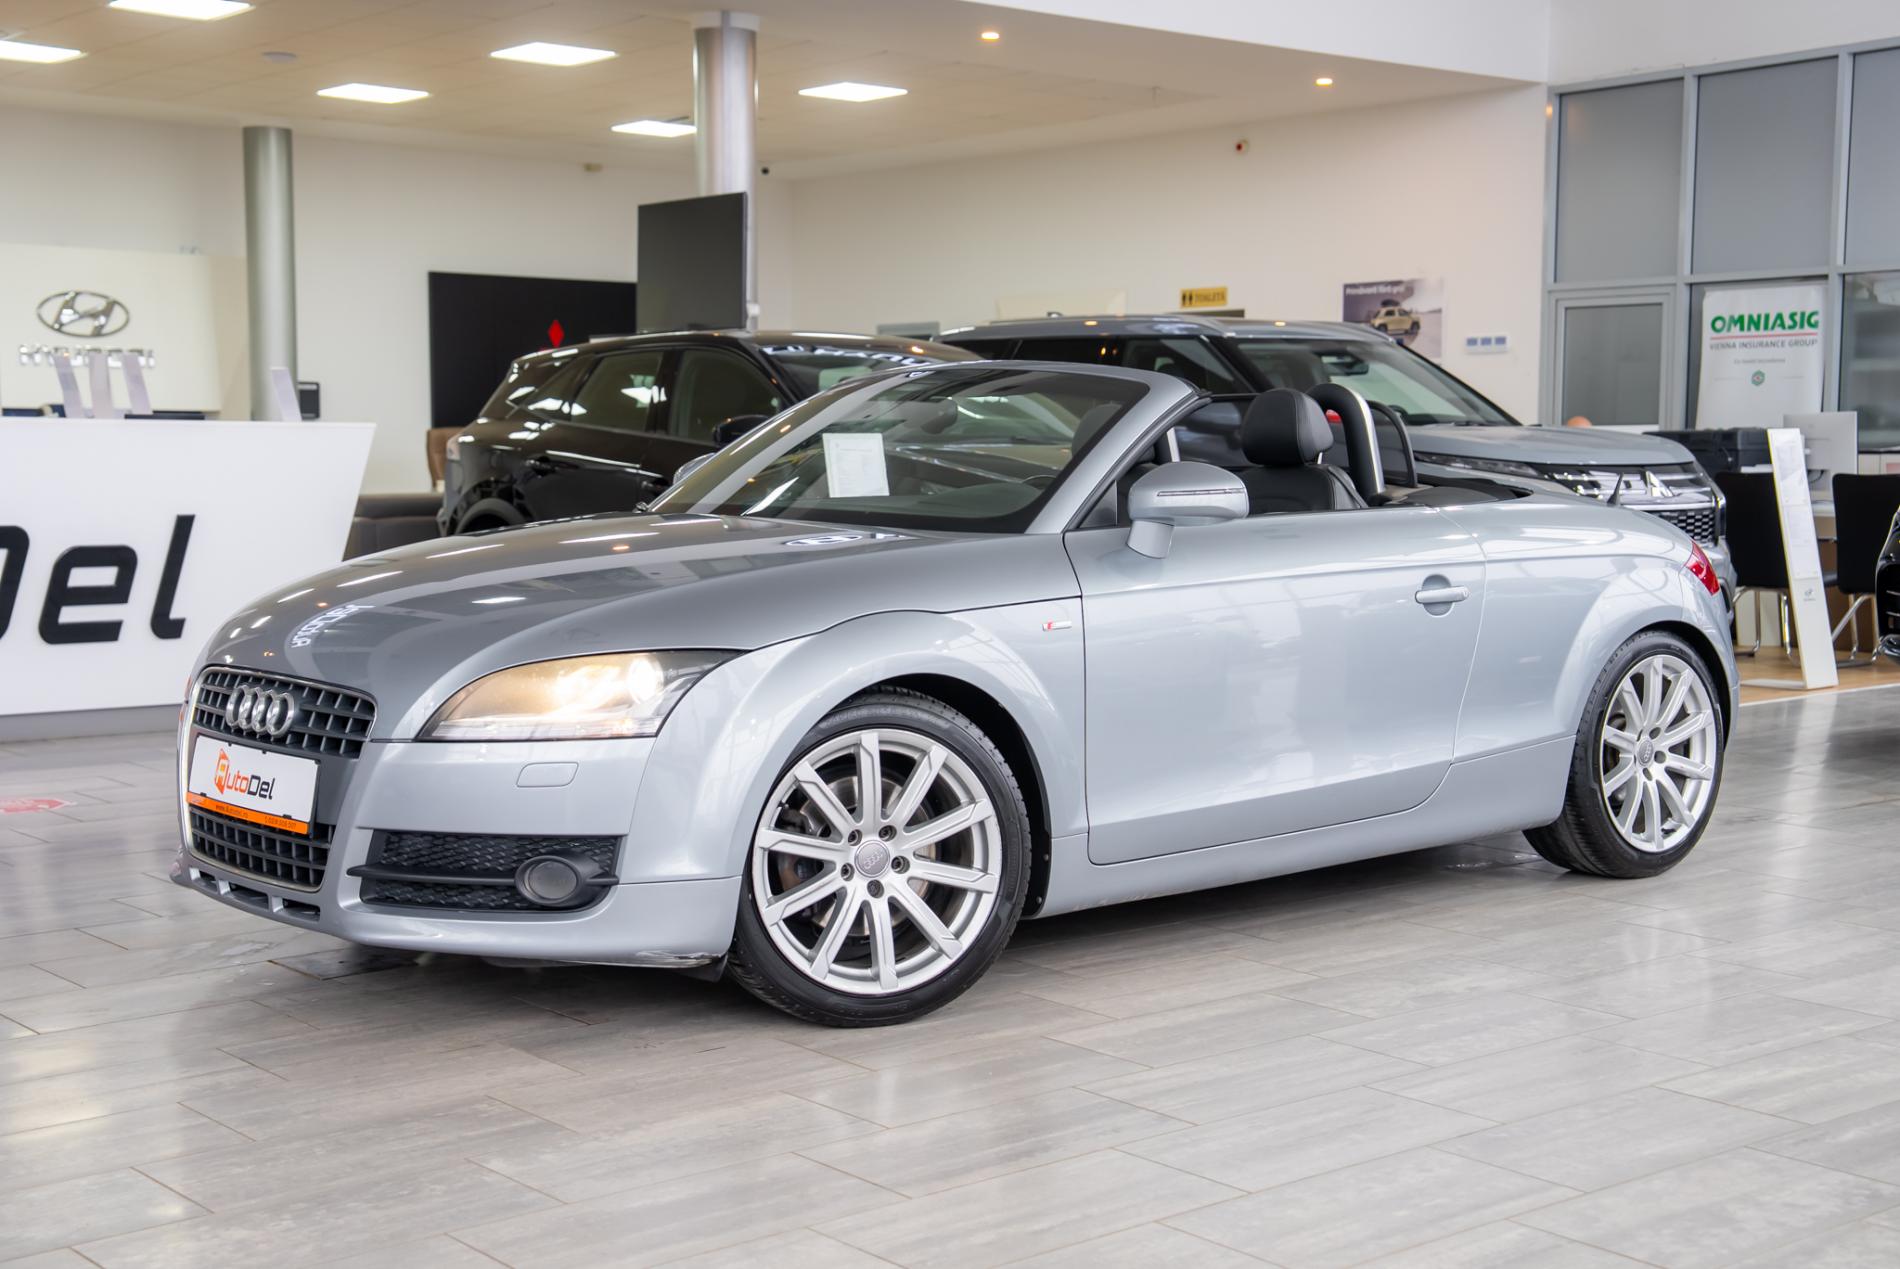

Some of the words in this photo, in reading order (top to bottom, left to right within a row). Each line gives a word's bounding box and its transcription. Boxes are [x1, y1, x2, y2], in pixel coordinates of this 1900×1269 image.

[1710, 310, 1820, 333] OMNIASIG
[1709, 342, 1737, 350] VIENNA
[1738, 340, 1785, 349] INSURANCE
[1787, 338, 1818, 348] GROUP
[0, 513, 195, 645] el
[215, 748, 276, 800] AutoDel
